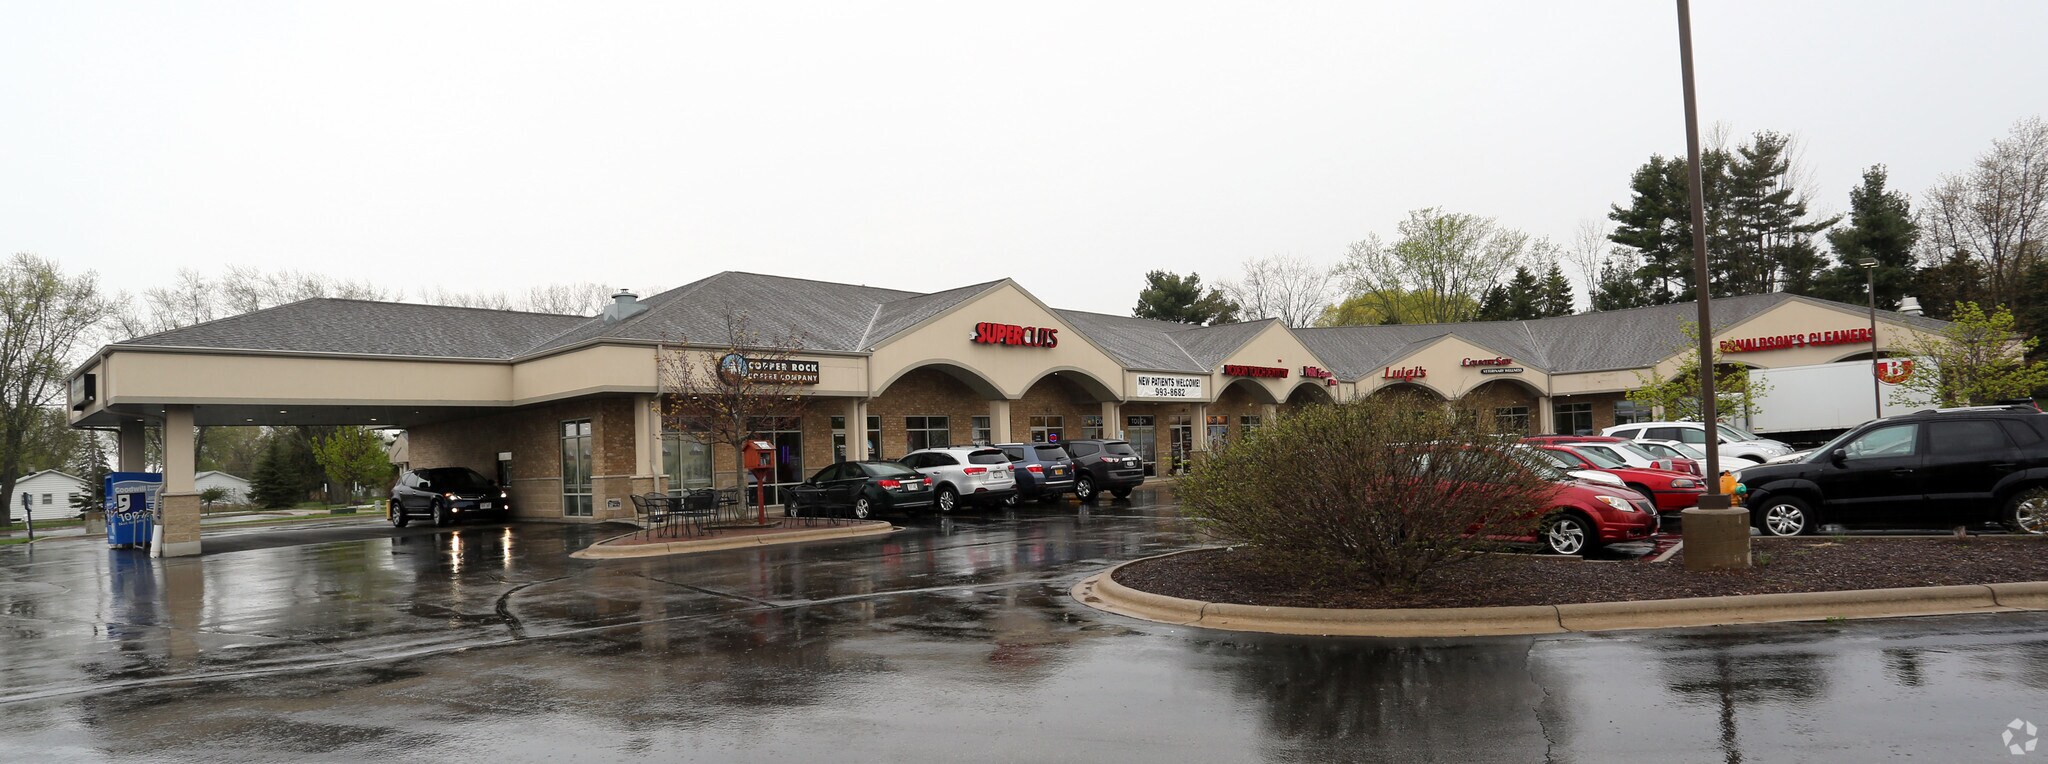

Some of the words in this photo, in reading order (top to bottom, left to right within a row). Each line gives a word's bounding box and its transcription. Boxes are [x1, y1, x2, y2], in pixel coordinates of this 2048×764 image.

[975, 322, 1058, 348] SUPERCUTS
[1720, 334, 1805, 352] DONALDSON'S
[1809, 328, 1873, 347] CLEANERS
[748, 361, 788, 371] COPPER
[791, 363, 818, 372] ROCK
[1886, 359, 1904, 376] B
[1384, 366, 1427, 382] Luigi's
[1138, 376, 1150, 386] NEW
[1151, 377, 1175, 387] PATIENTS
[1176, 378, 1201, 388] WELCOME!
[1154, 387, 1186, 397] 993-8682
[115, 485, 147, 493] Goodwill
